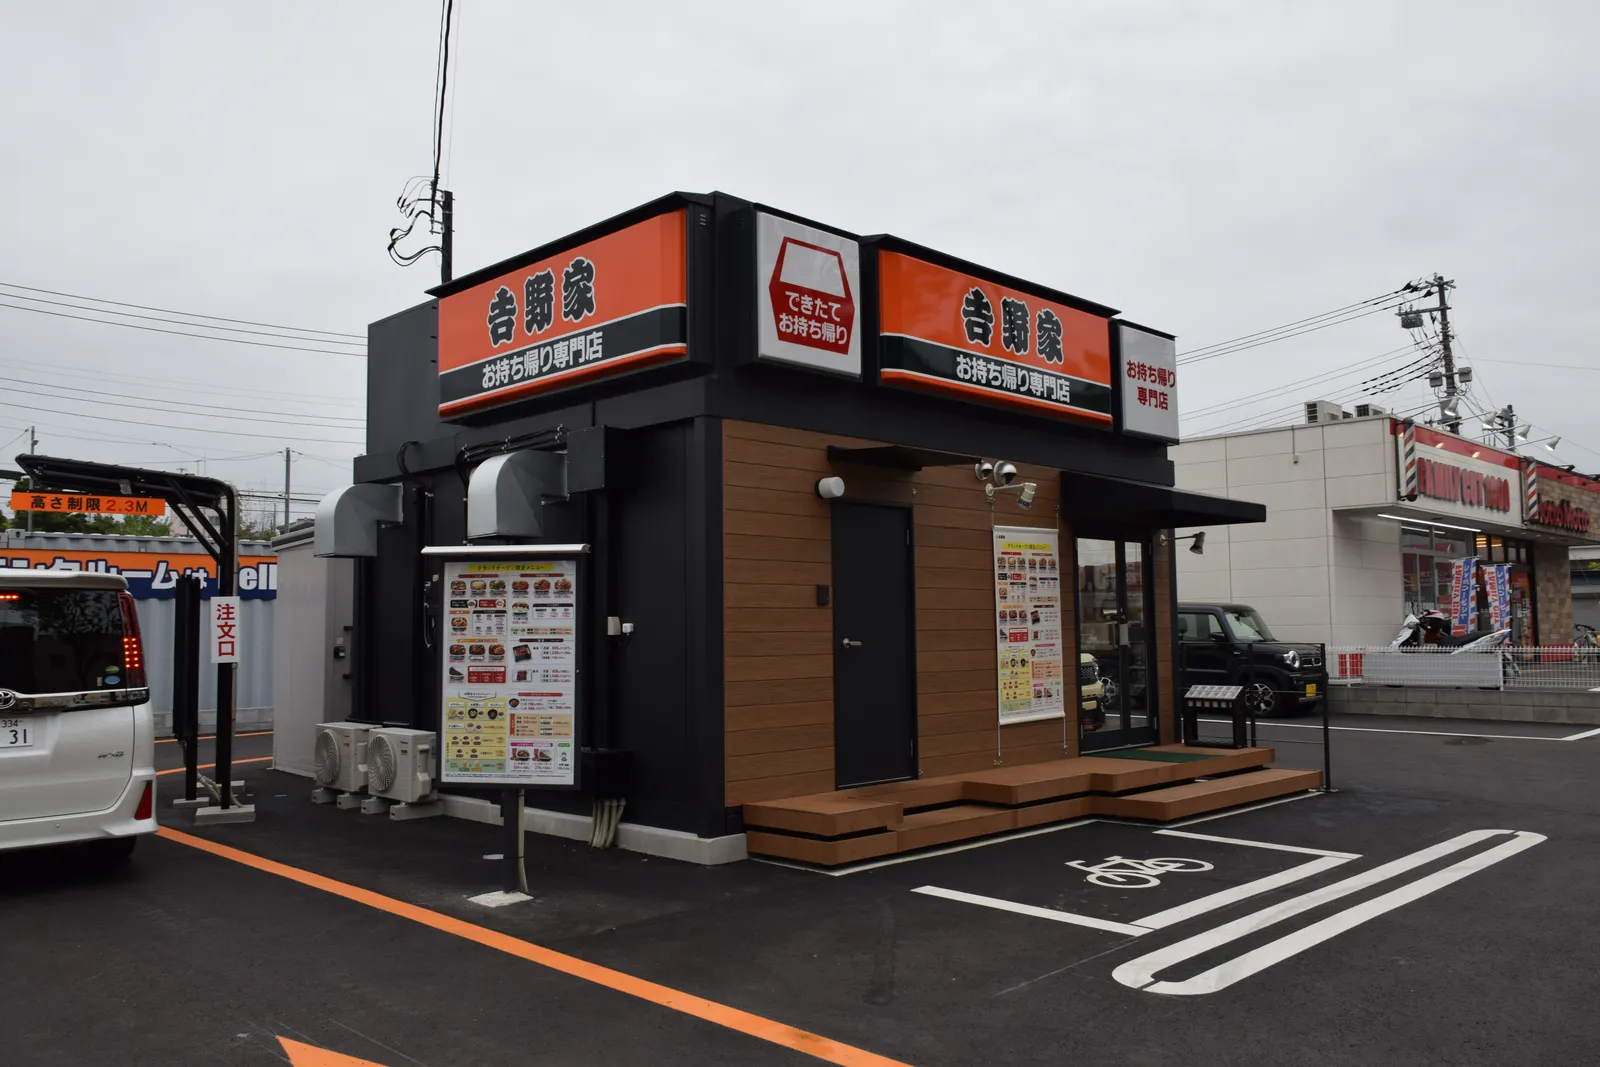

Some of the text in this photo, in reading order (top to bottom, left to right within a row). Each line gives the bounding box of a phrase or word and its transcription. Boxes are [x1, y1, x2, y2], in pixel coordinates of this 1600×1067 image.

[784, 290, 843, 322] できたて
[778, 311, 848, 346] お持ち帰り
[481, 330, 603, 390] お持ち帰り専門店
[955, 354, 1071, 404] お持ち帰り専門店
[1126, 359, 1176, 389] お持ち帰り
[1136, 385, 1169, 411] 専門店
[1417, 457, 1460, 501] FAMILY
[1460, 468, 1483, 506] CUT
[216, 603, 236, 657] 注文口
